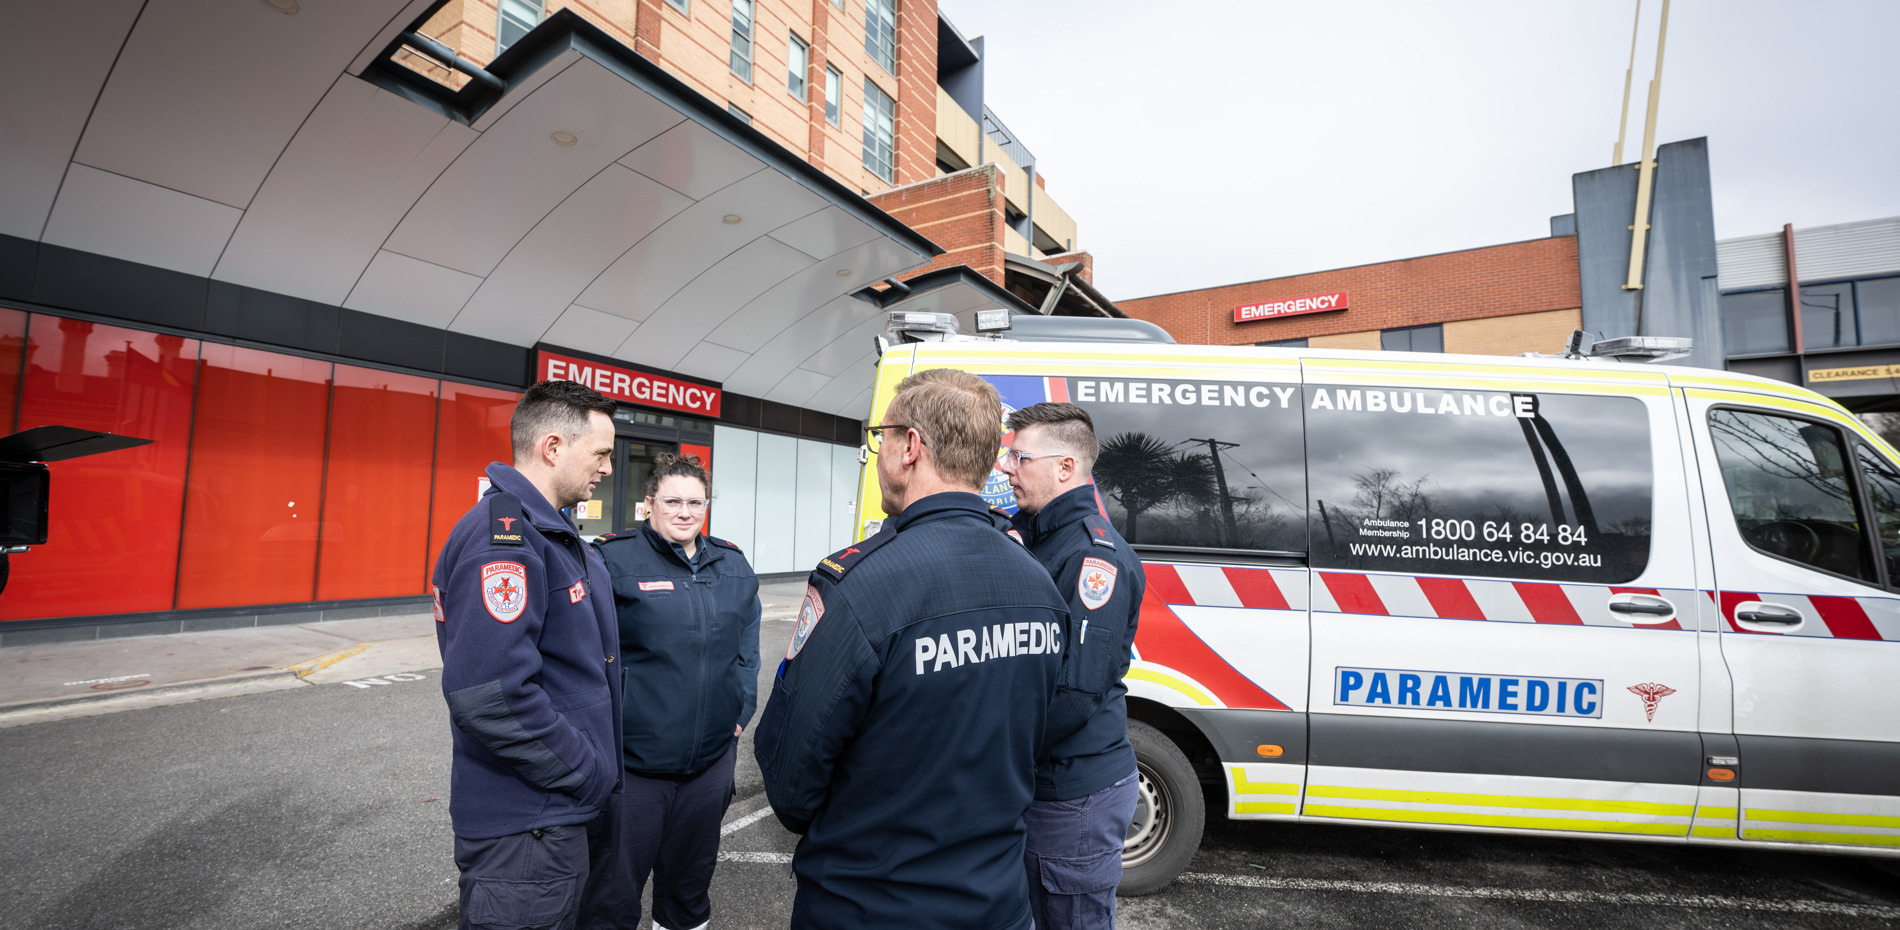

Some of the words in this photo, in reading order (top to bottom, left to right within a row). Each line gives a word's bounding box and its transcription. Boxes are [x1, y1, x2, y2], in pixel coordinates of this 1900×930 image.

[1241, 294, 1339, 319] EMERGENCY
[547, 358, 716, 411] EMERGENCY
[1812, 368, 1879, 379] CLEARANCE
[1077, 380, 1295, 408] EMERGENCY
[1311, 388, 1536, 419] AMBULANCE
[1359, 527, 1410, 539] Membership
[1363, 518, 1410, 528] Ambulance
[1417, 517, 1476, 541] 1800
[1482, 520, 1513, 543] 64
[1520, 522, 1550, 545] 84
[1557, 524, 1588, 546] 84
[1085, 559, 1116, 573] PARAMEDIC
[1349, 542, 1602, 569] www.ambulance.vic.gov.au
[485, 563, 523, 575] PARAMEDIC
[915, 621, 1061, 675] PARAMEDIC
[342, 673, 426, 688] NO
[1339, 670, 1598, 715] PARAMEDIC
